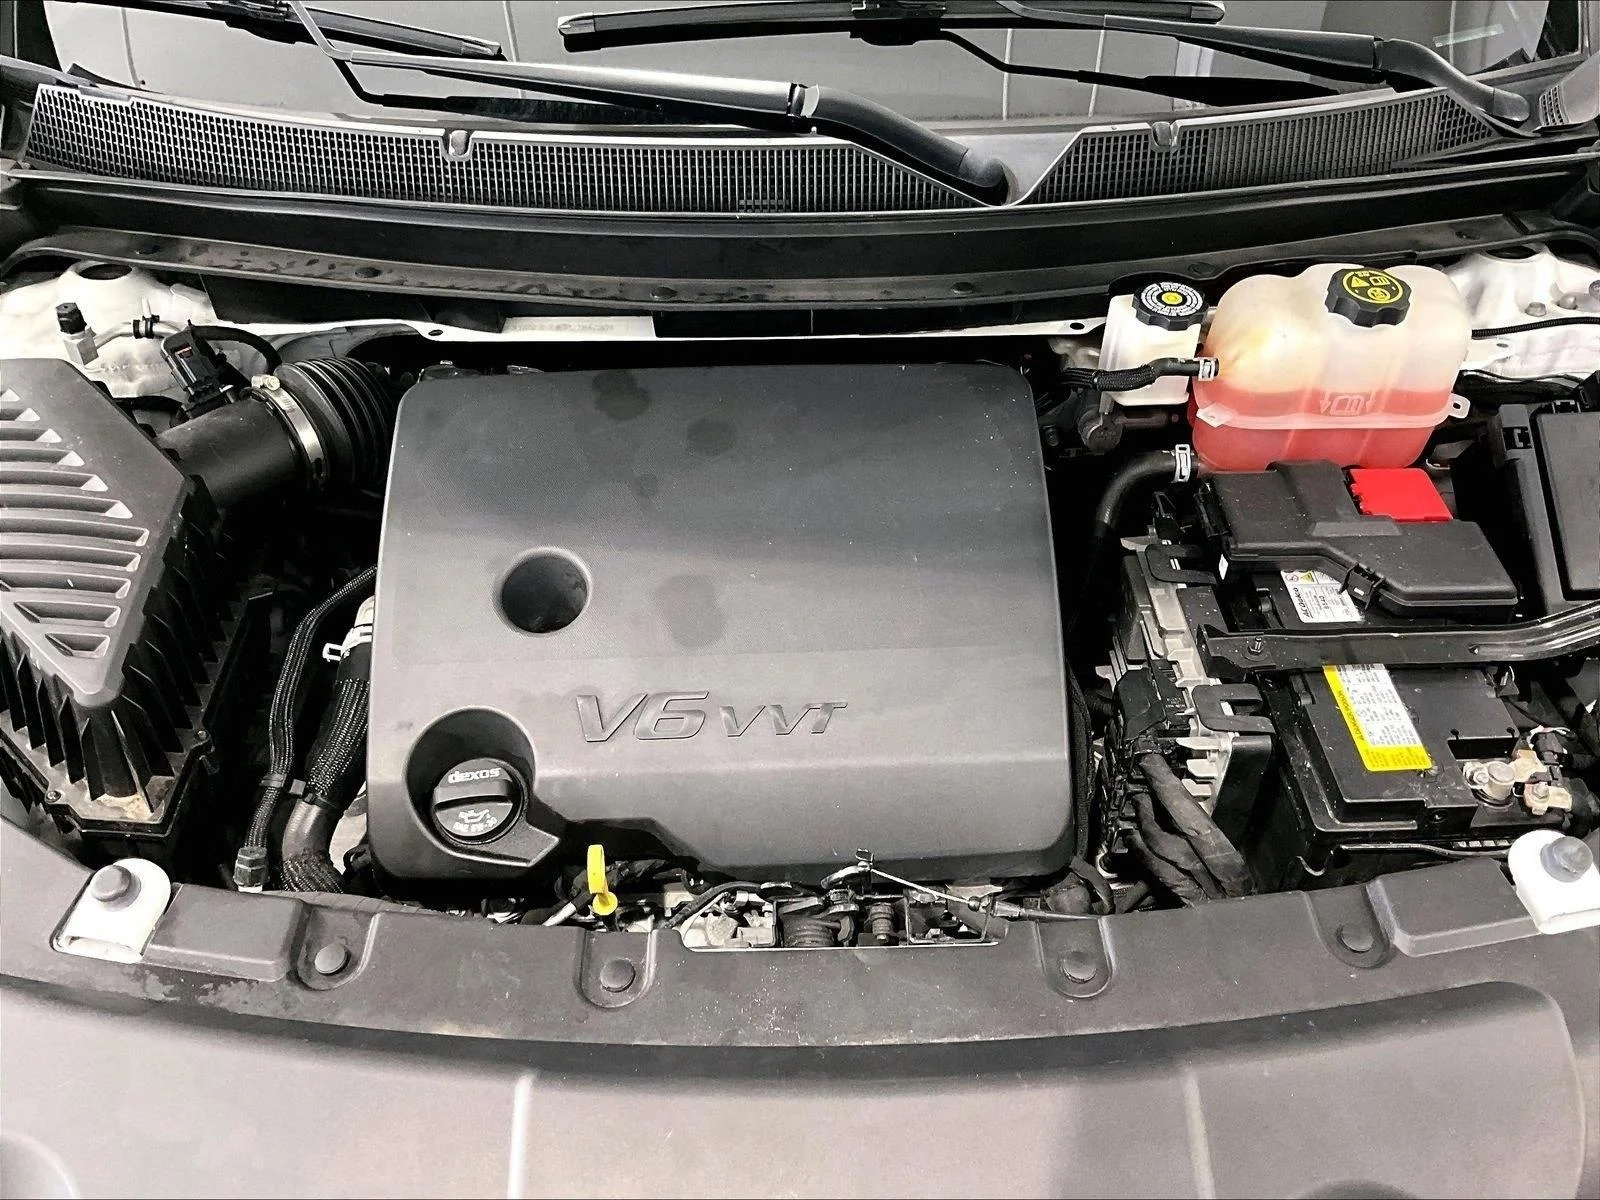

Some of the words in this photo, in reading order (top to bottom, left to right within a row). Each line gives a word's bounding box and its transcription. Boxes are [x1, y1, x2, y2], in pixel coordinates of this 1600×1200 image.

[576, 690, 710, 743] V6
[719, 701, 849, 738] VVT
[447, 767, 502, 784] dexos
